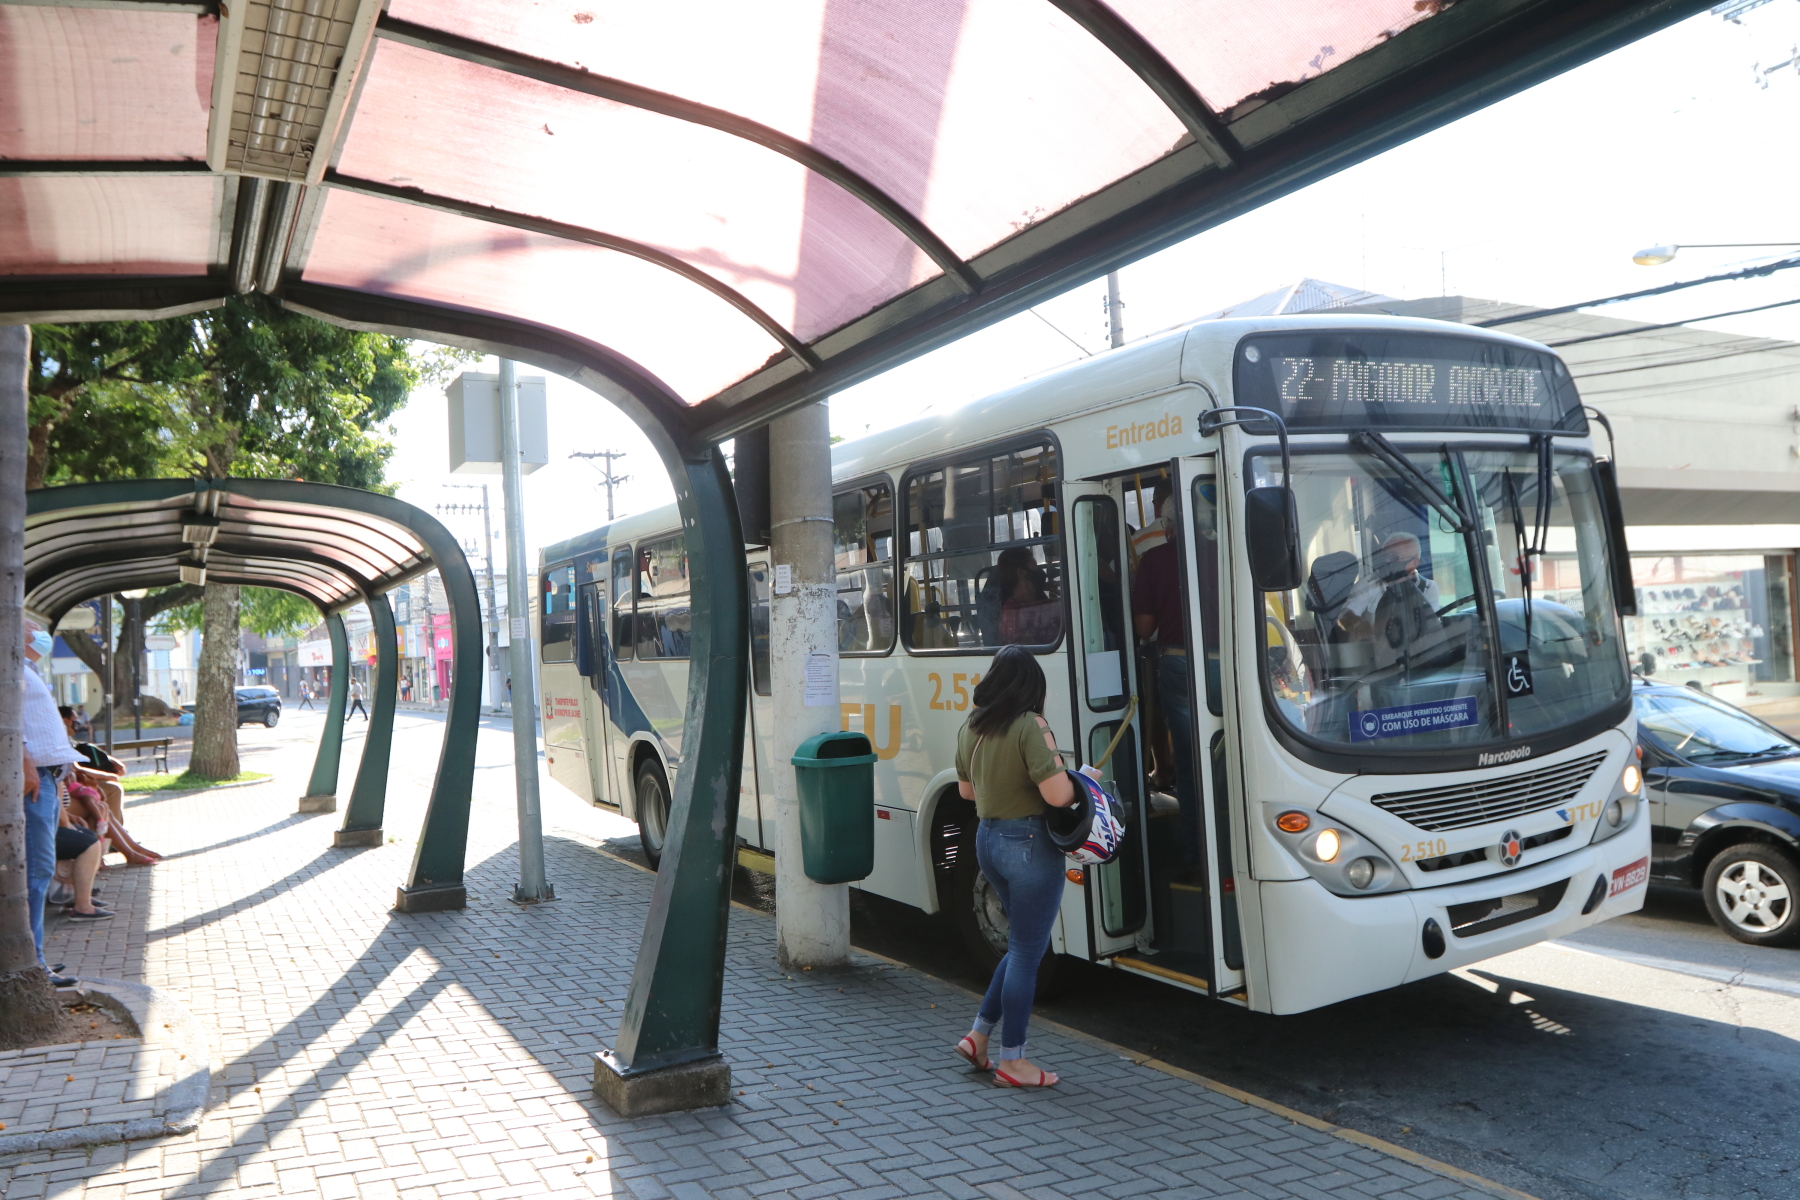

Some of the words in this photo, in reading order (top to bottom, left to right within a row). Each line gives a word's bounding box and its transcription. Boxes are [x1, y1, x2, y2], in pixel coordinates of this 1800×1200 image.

[1449, 365, 1542, 407] ANDRADE
[1106, 412, 1183, 450] Entrada
[1382, 710, 1413, 721] EMBARQUE
[1413, 706, 1443, 717] PERMITIDO
[1443, 702, 1468, 714] SOMENTE
[1382, 721, 1402, 732] COM
[1403, 719, 1420, 730] USO
[1420, 717, 1431, 727] DE
[1432, 712, 1469, 726] MÁSCARA
[1478, 745, 1531, 766] Marcopolo
[1565, 799, 1603, 826] JTU
[1400, 838, 1447, 863] 2.510
